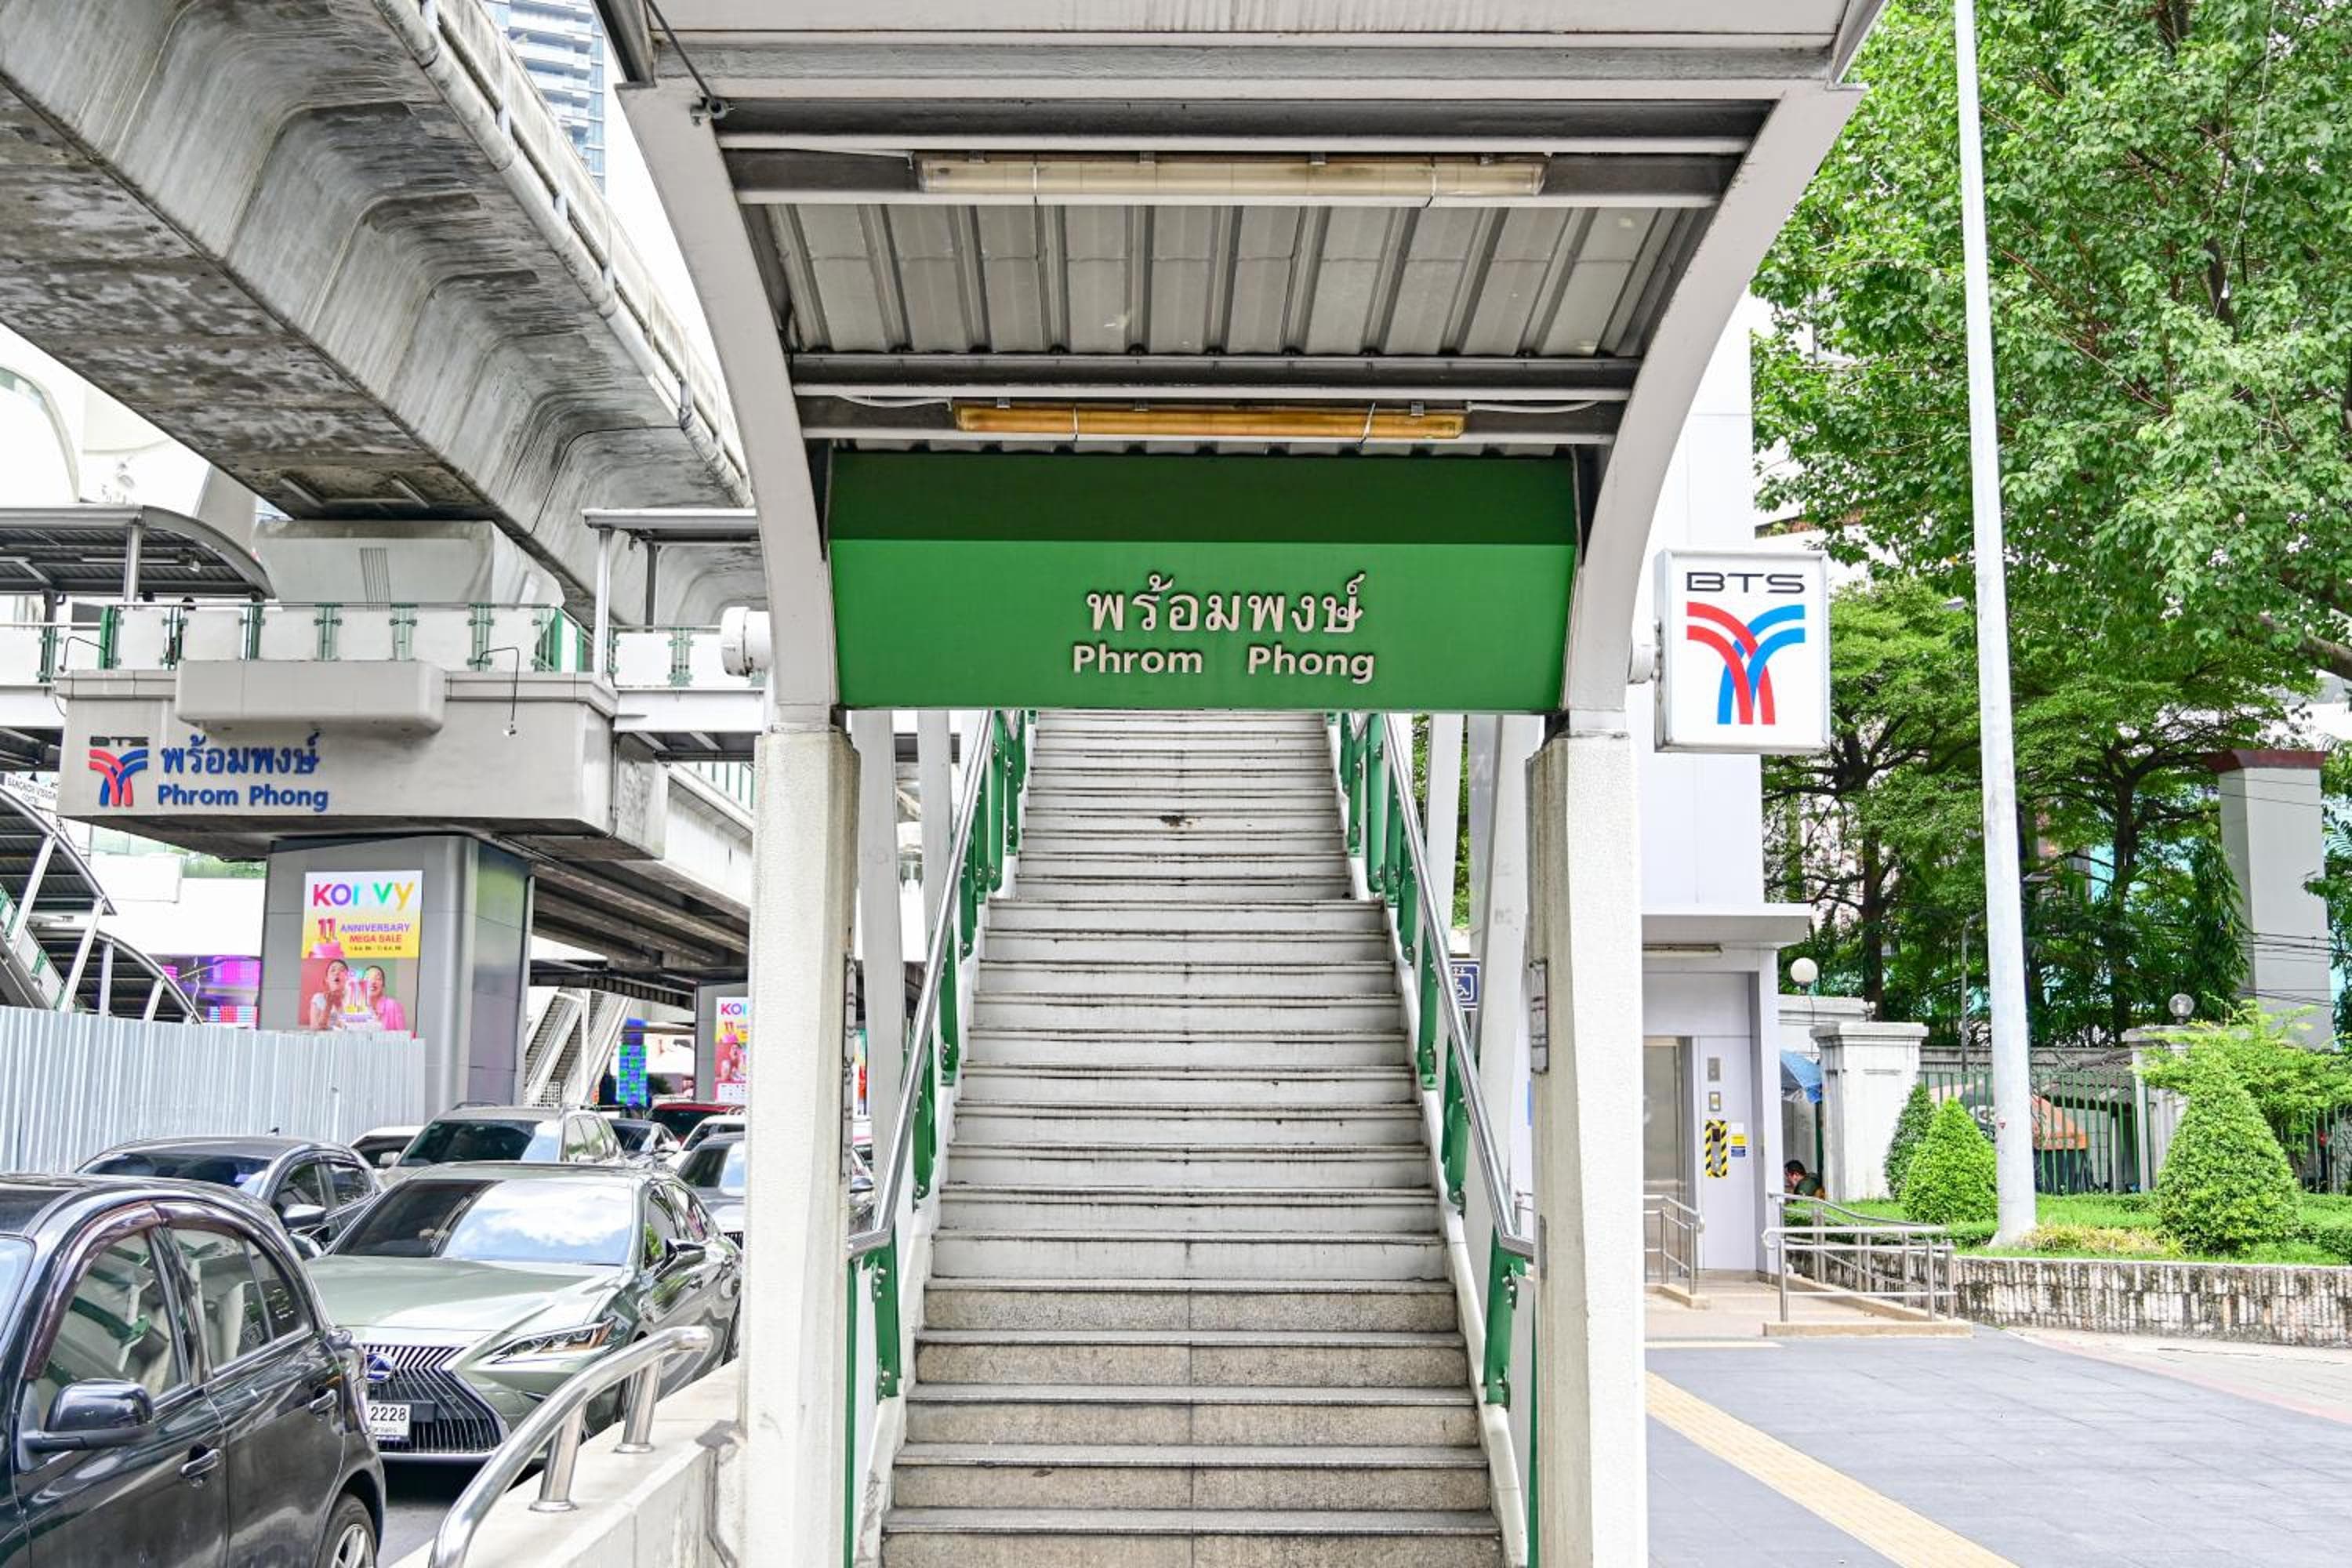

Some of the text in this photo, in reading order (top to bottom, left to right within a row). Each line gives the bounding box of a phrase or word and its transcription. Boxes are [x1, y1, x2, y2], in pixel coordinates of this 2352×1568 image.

[1686, 572, 1806, 593] BTS
[1087, 572, 1366, 633] พร้อมพงษ์
[1073, 643, 1374, 684] Phrom Phong
[89, 736, 149, 746] BTS
[161, 731, 321, 775] พร้อมพงษ์
[158, 784, 328, 813] Phrom Phong
[340, 924, 410, 932] ANNIVERSARY
[350, 934, 402, 943] MEGA SALE
[370, 1406, 407, 1421] 2228
